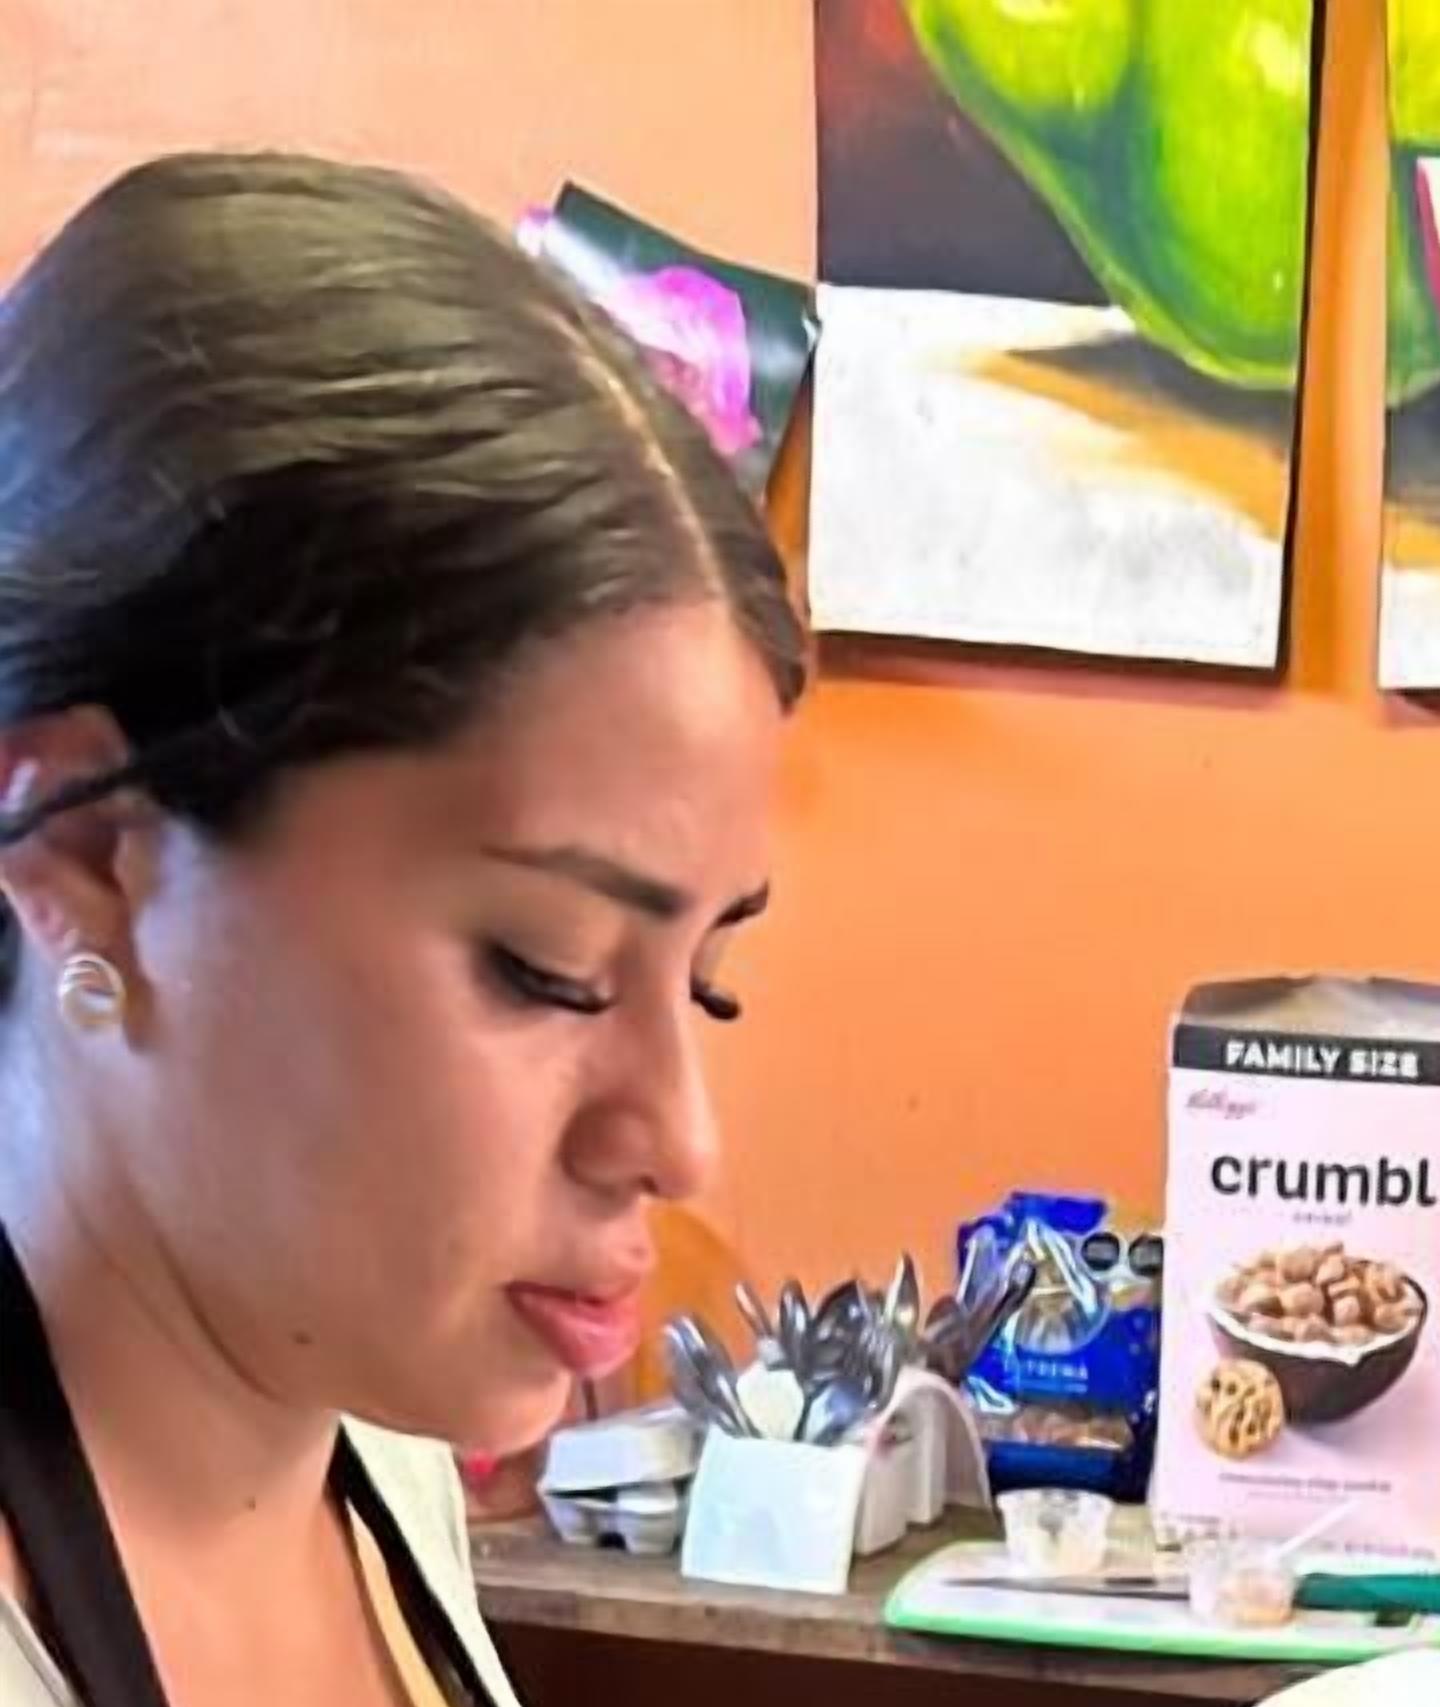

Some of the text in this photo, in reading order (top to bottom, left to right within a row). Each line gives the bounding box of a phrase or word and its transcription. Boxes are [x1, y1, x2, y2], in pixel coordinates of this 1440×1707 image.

[1225, 1039, 1419, 1079] FAMILY SIZE
[1211, 1155, 1438, 1207] crumbl
